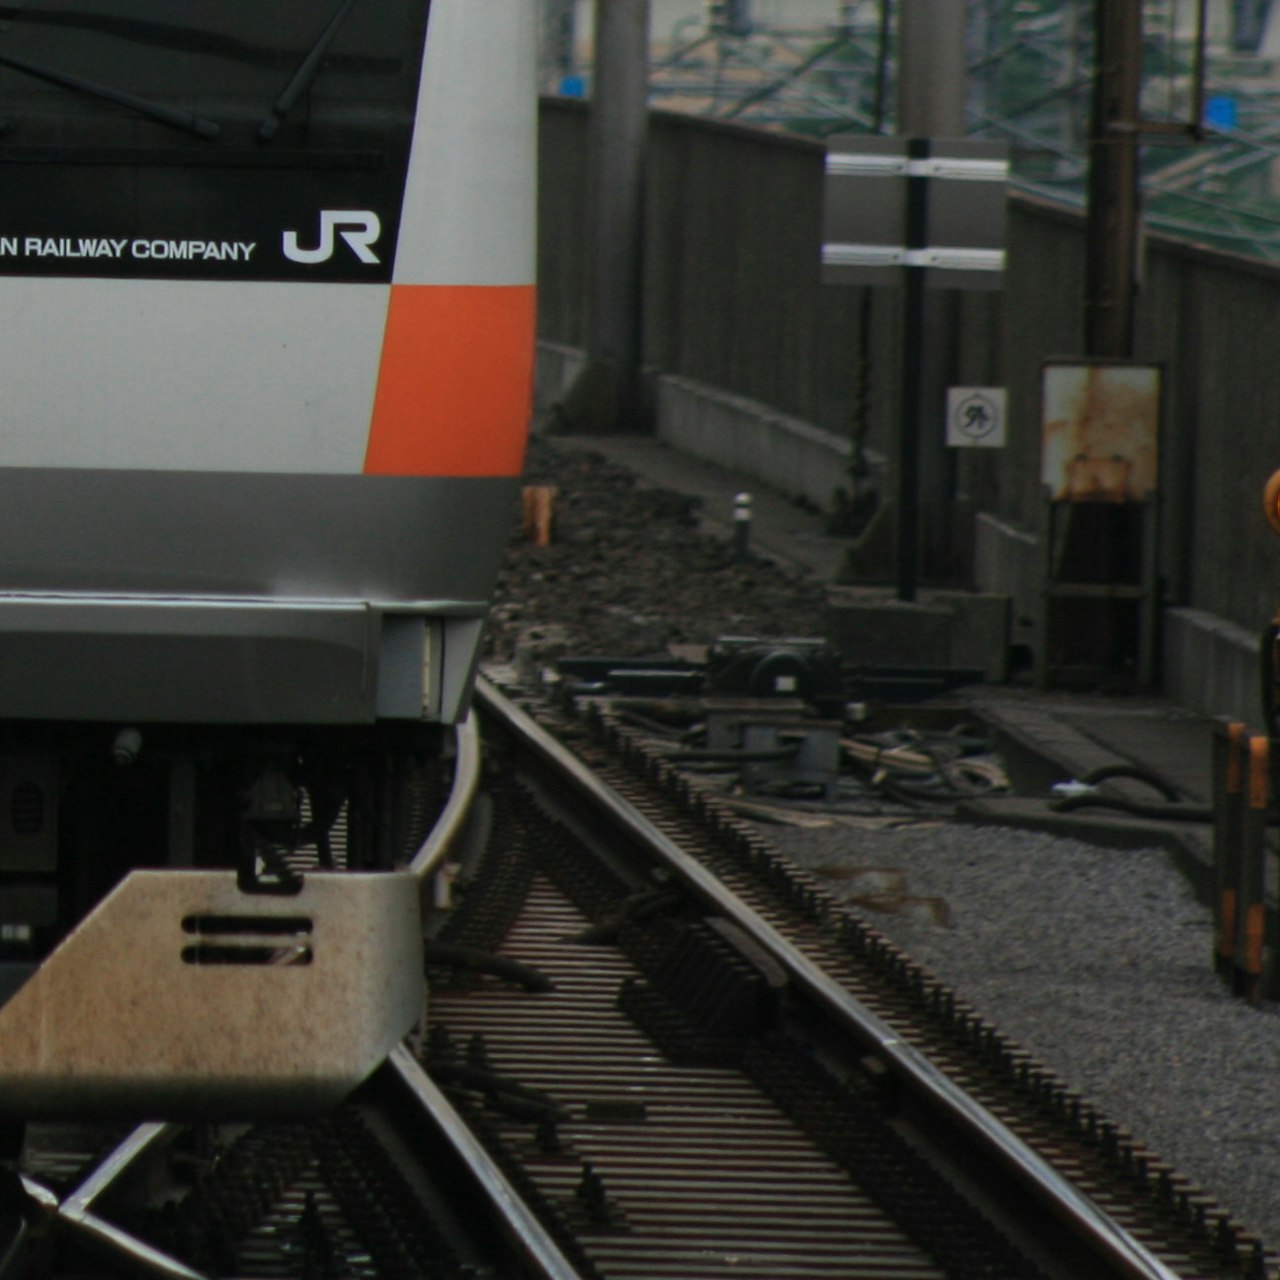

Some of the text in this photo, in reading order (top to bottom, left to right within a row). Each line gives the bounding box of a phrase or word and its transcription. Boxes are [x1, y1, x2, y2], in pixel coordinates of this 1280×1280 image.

[25, 237, 126, 259] RAILWAY
[131, 239, 256, 261] COMPANY
[282, 209, 381, 264] JR
